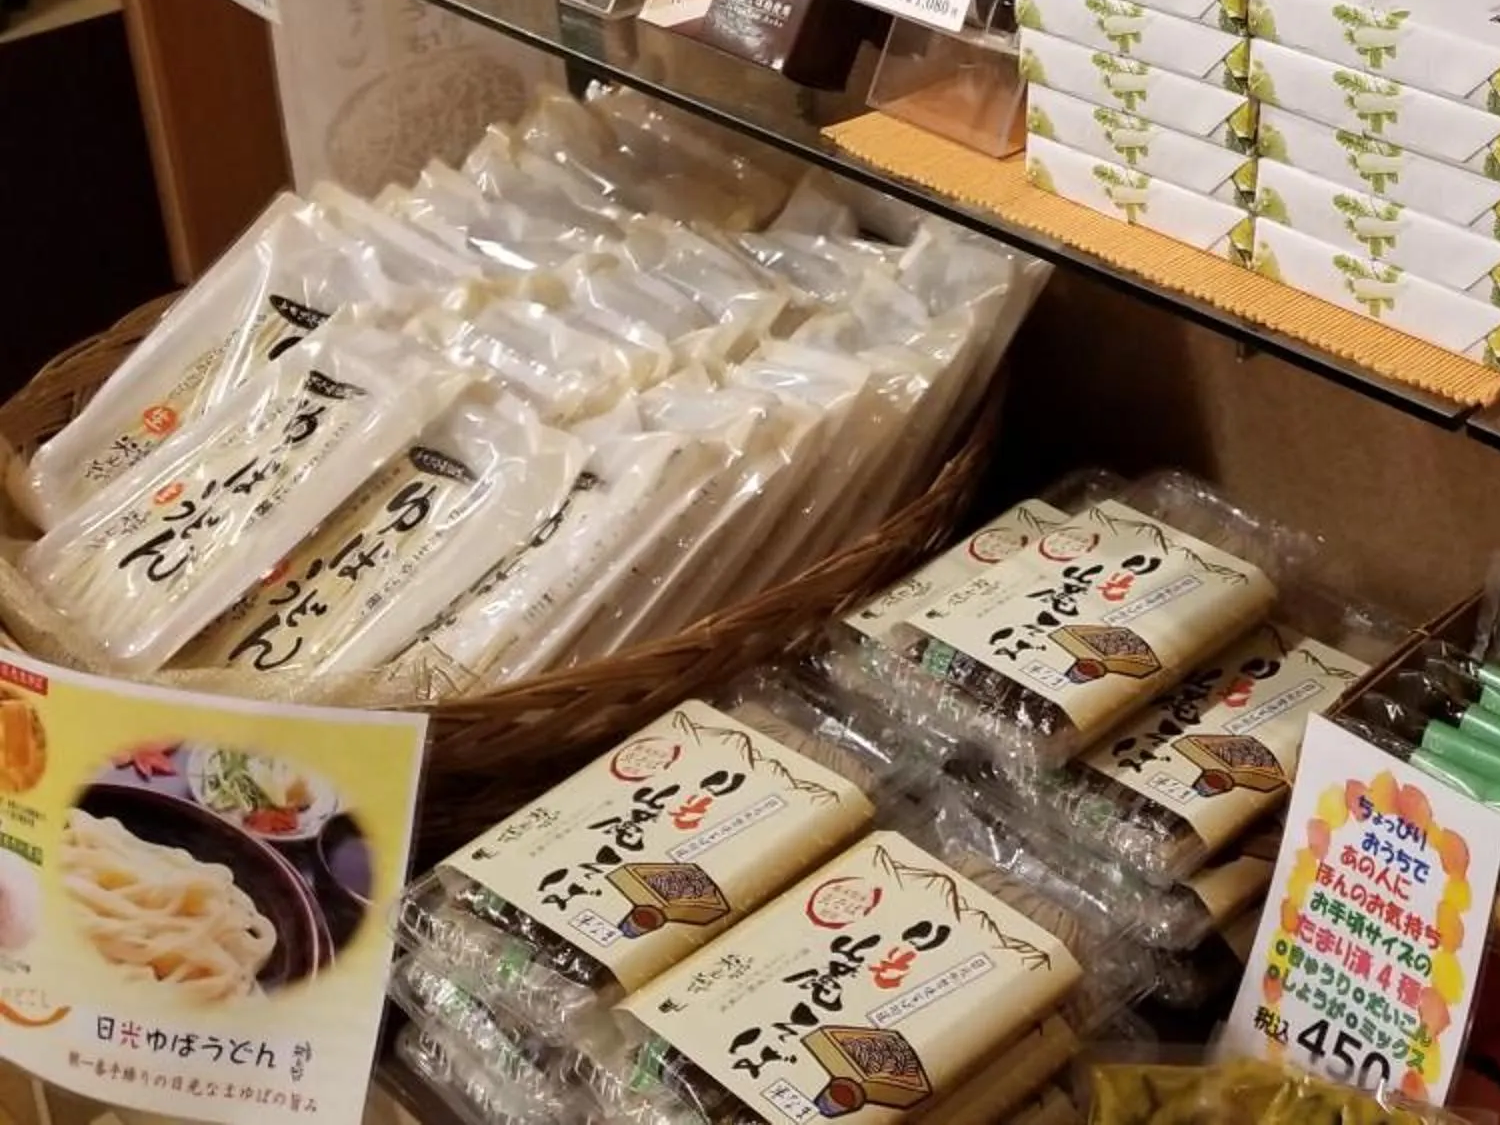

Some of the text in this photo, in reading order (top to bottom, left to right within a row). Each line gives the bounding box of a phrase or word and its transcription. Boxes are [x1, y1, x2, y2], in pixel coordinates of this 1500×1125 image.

[1357, 794, 1429, 852] ちょっぴり
[1340, 845, 1412, 902] あの人に
[1361, 832, 1431, 884] おうちで
[1309, 891, 1433, 978] お手頃サイズの
[1316, 862, 1443, 950] ほんのお気持ち
[96, 1017, 277, 1069] 日光ゆばうどん
[1253, 1005, 1391, 1092] 税込 450
